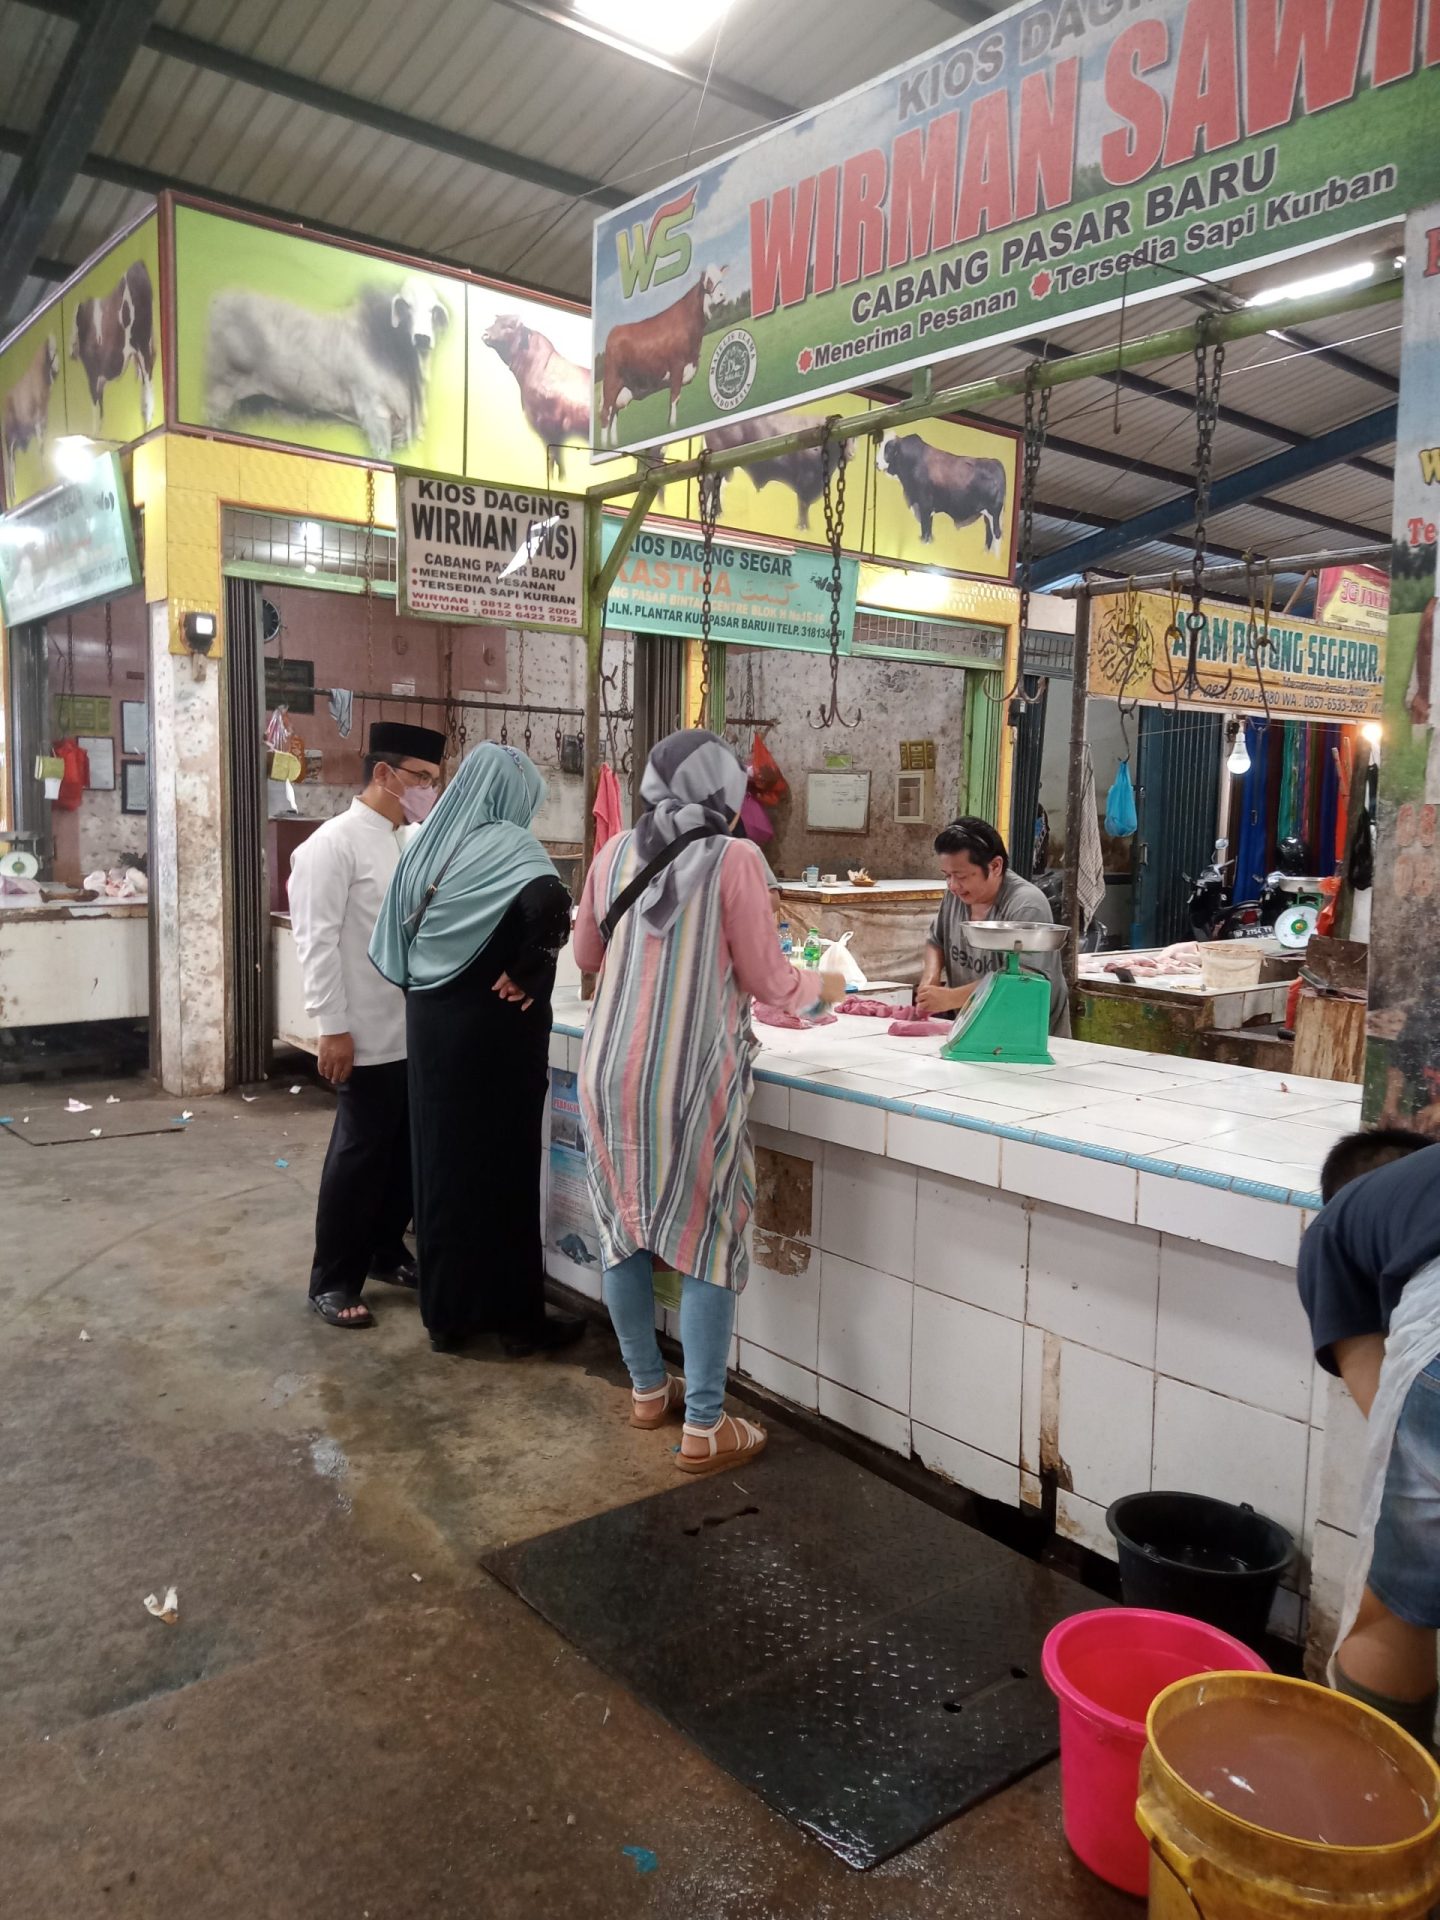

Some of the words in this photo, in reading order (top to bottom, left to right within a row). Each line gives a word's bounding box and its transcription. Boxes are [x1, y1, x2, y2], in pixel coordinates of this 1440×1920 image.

[899, 34, 1004, 121] KIOS
[1020, 0, 1141, 65] DAG
[750, 55, 1079, 319] WIRMAN
[1101, 0, 1440, 186] SAWI
[617, 184, 696, 299] WS
[852, 250, 989, 323] CABANG
[1002, 201, 1130, 273] PASAR
[1146, 148, 1276, 227] BARU
[1056, 239, 1176, 292] Tersedia
[1187, 208, 1255, 250] Sapi
[1267, 165, 1396, 228] Kurban
[815, 323, 911, 368] Menerima
[919, 288, 1017, 335] Pesanan
[419, 479, 475, 506] KIOS
[484, 490, 569, 519] DAGING
[412, 503, 517, 552] WIRMAN
[425, 553, 481, 570] CABANG
[532, 567, 565, 581] BARU
[630, 534, 665, 557] IOS
[670, 540, 734, 568] DAGING
[739, 551, 792, 577] SEGAR
[419, 568, 491, 584] MENERIMA
[496, 577, 555, 592] PESANAN
[420, 579, 485, 595] TERSEDIA
[490, 588, 519, 599] SAPI
[523, 592, 576, 605] KURBAN
[411, 601, 469, 614] BUYUNG
[481, 608, 512, 618] 0852
[515, 612, 545, 621] 6422
[549, 615, 578, 625] 5255
[412, 591, 469, 605] WIRMAN
[480, 600, 511, 610] 0812
[514, 603, 543, 613] 6101
[548, 607, 577, 616] 2002
[608, 602, 632, 616] JLN.
[635, 605, 683, 622] PLANTAR
[709, 614, 739, 628] PASAR
[741, 620, 768, 632] BARU
[776, 622, 800, 636] TELP.
[1232, 621, 1303, 674] POTONG
